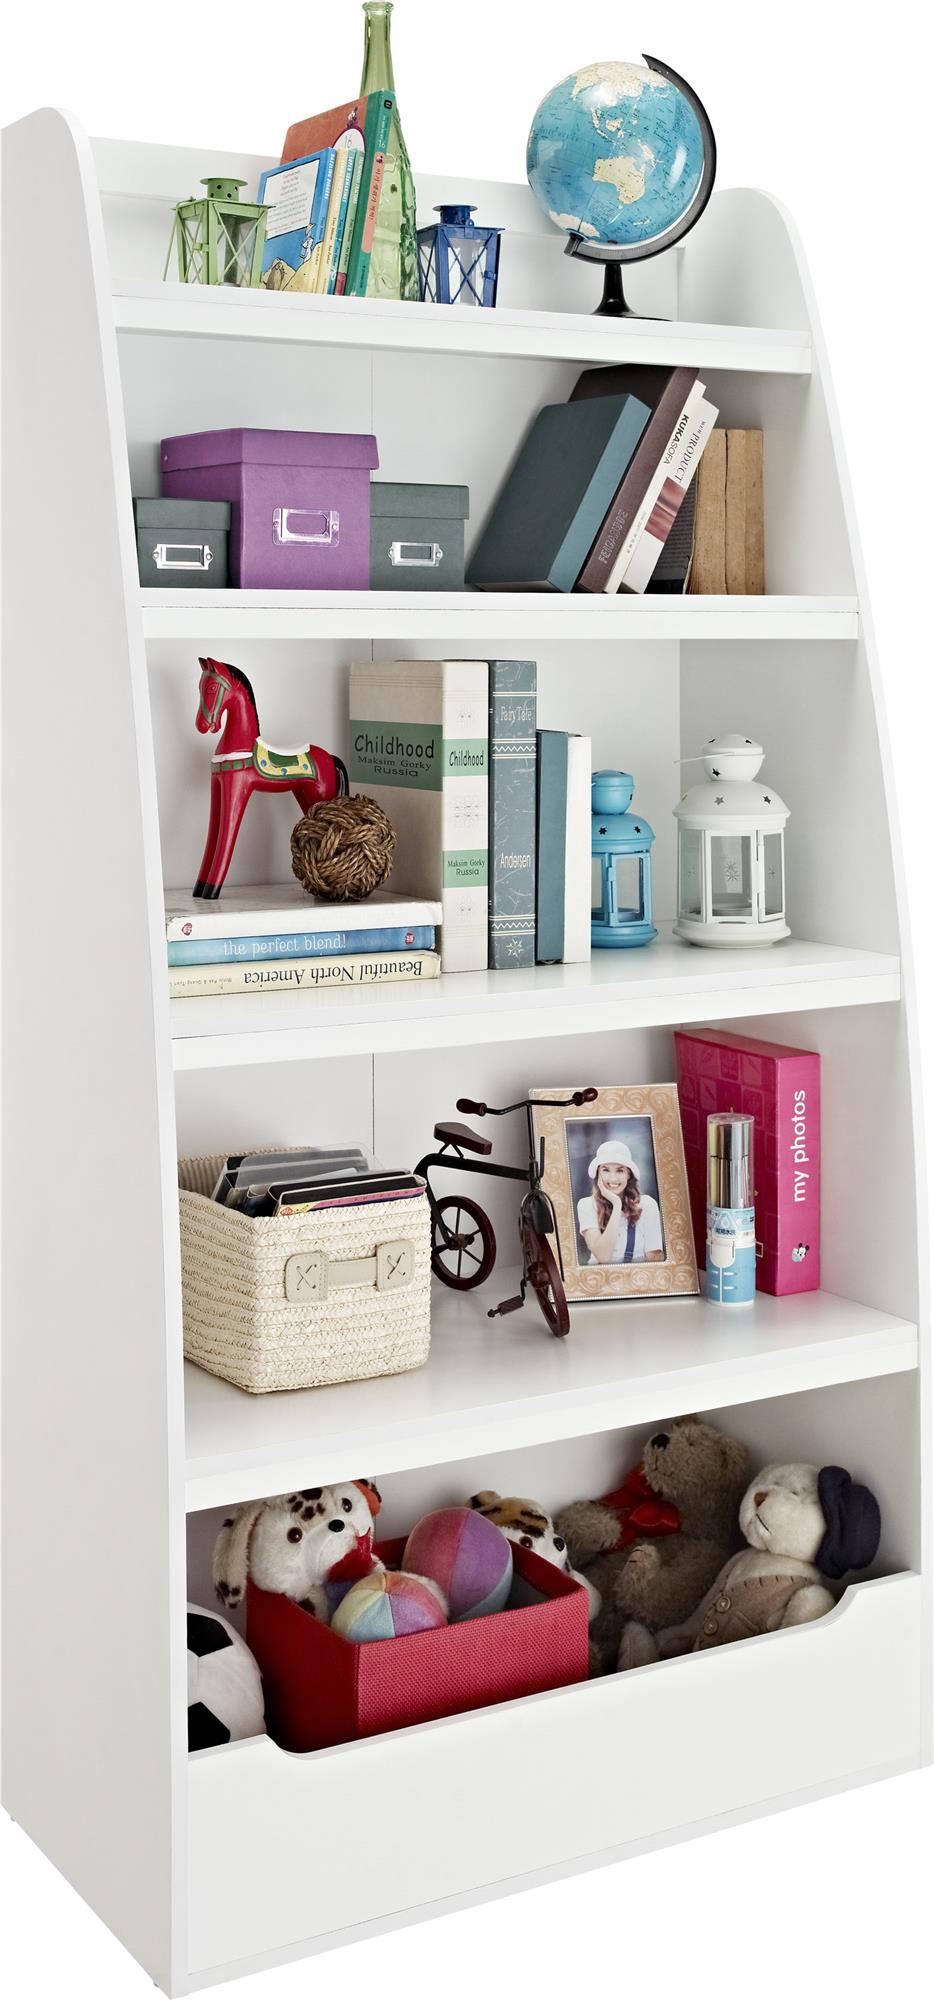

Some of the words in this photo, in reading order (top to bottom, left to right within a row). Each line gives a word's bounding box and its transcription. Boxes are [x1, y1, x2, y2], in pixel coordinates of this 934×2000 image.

[664, 414, 690, 465] KUKASOFA
[674, 432, 701, 484] PRODUCT
[500, 705, 516, 727] Fairy
[516, 705, 533, 721] Tale
[354, 734, 435, 759] Childhood
[357, 755, 396, 767] Maksim
[400, 759, 432, 772] Gorky
[449, 750, 484, 767] Childhood
[373, 765, 419, 777] Russia
[447, 859, 468, 868] Maksim
[469, 858, 486, 869] Gorky
[500, 852, 531, 869] Andersen
[455, 868, 480, 876] Russia
[223, 940, 248, 956] the
[252, 937, 300, 958] perfect
[303, 933, 346, 951] blend!
[244, 968, 306, 988] America
[311, 966, 355, 983] North
[360, 960, 424, 981] Beautiful
[789, 1089, 810, 1164] photos
[793, 1170, 810, 1203] my
